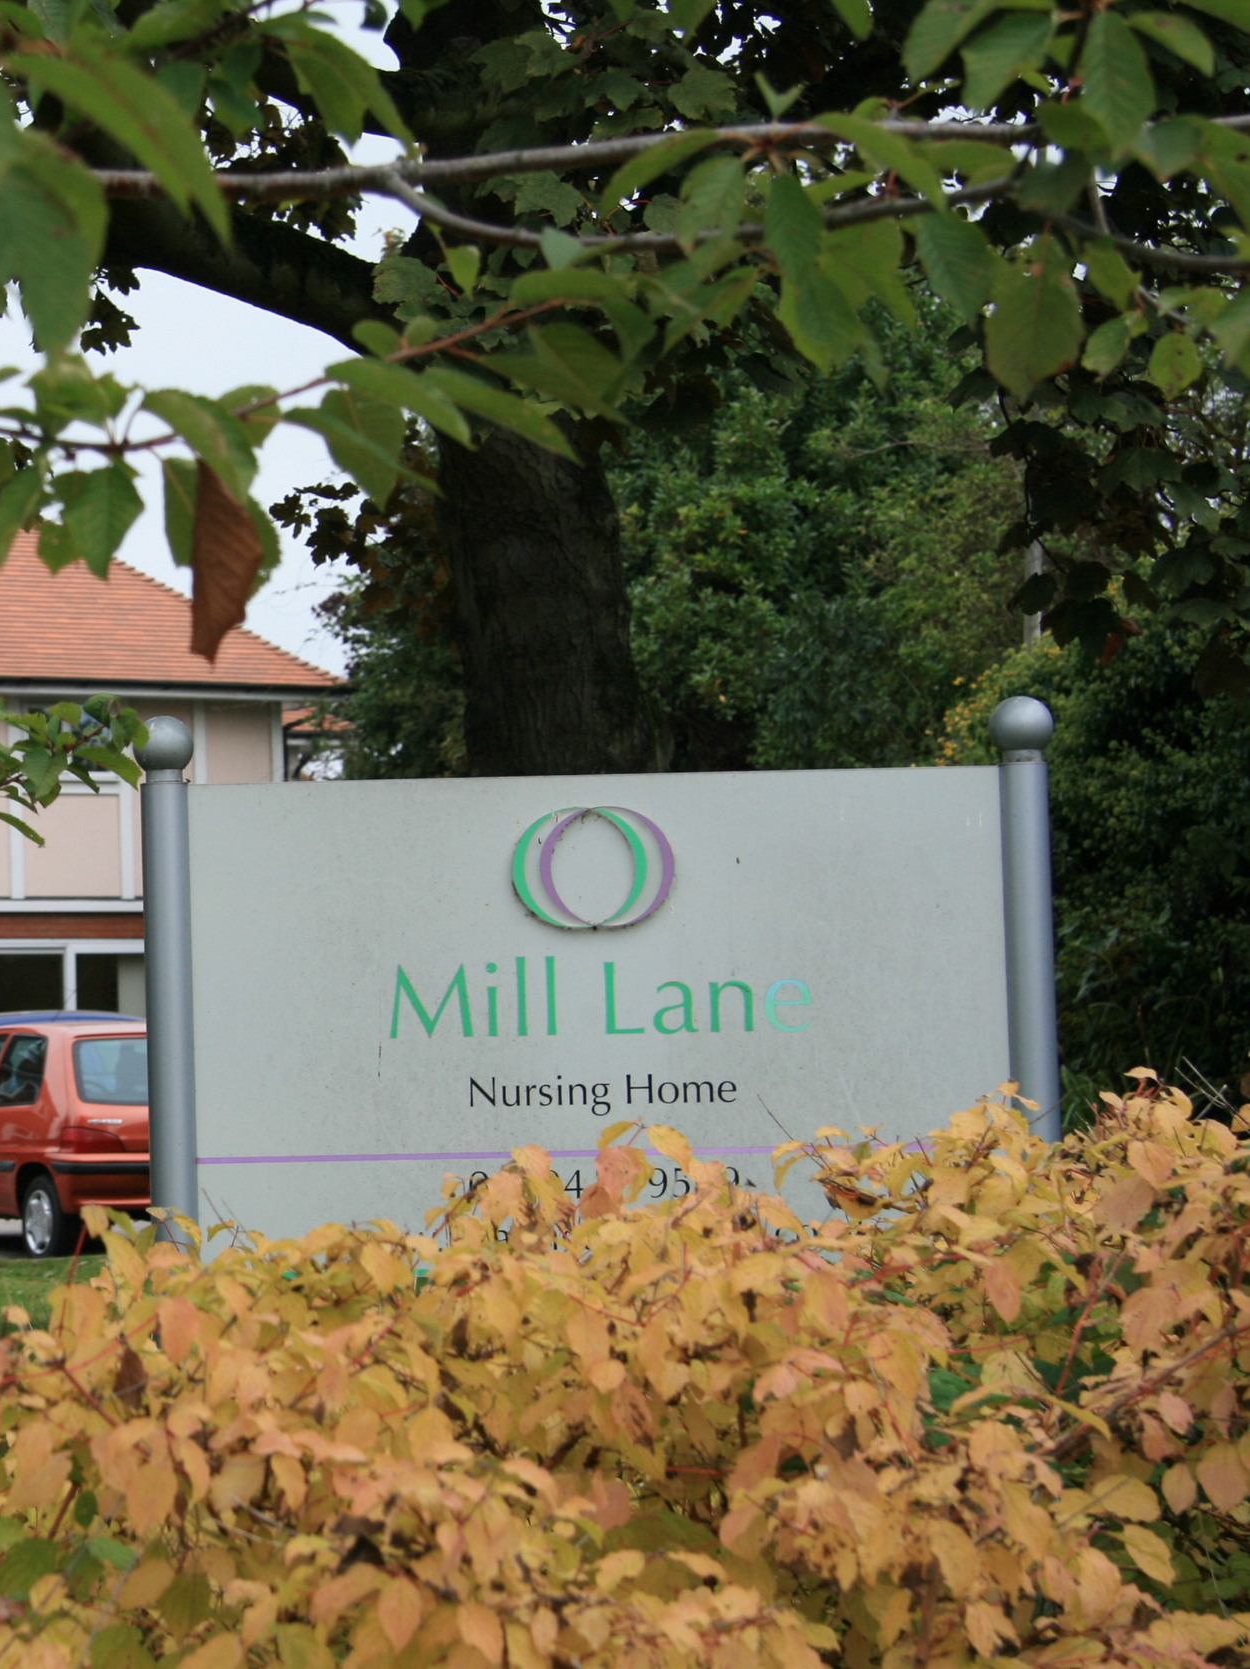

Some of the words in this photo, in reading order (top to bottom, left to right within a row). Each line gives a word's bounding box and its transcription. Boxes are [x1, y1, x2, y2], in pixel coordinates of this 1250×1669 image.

[389, 955, 558, 1040] Mill
[603, 961, 812, 1035] Lane
[468, 1074, 612, 1117] Nursing
[625, 1073, 738, 1105] Home
